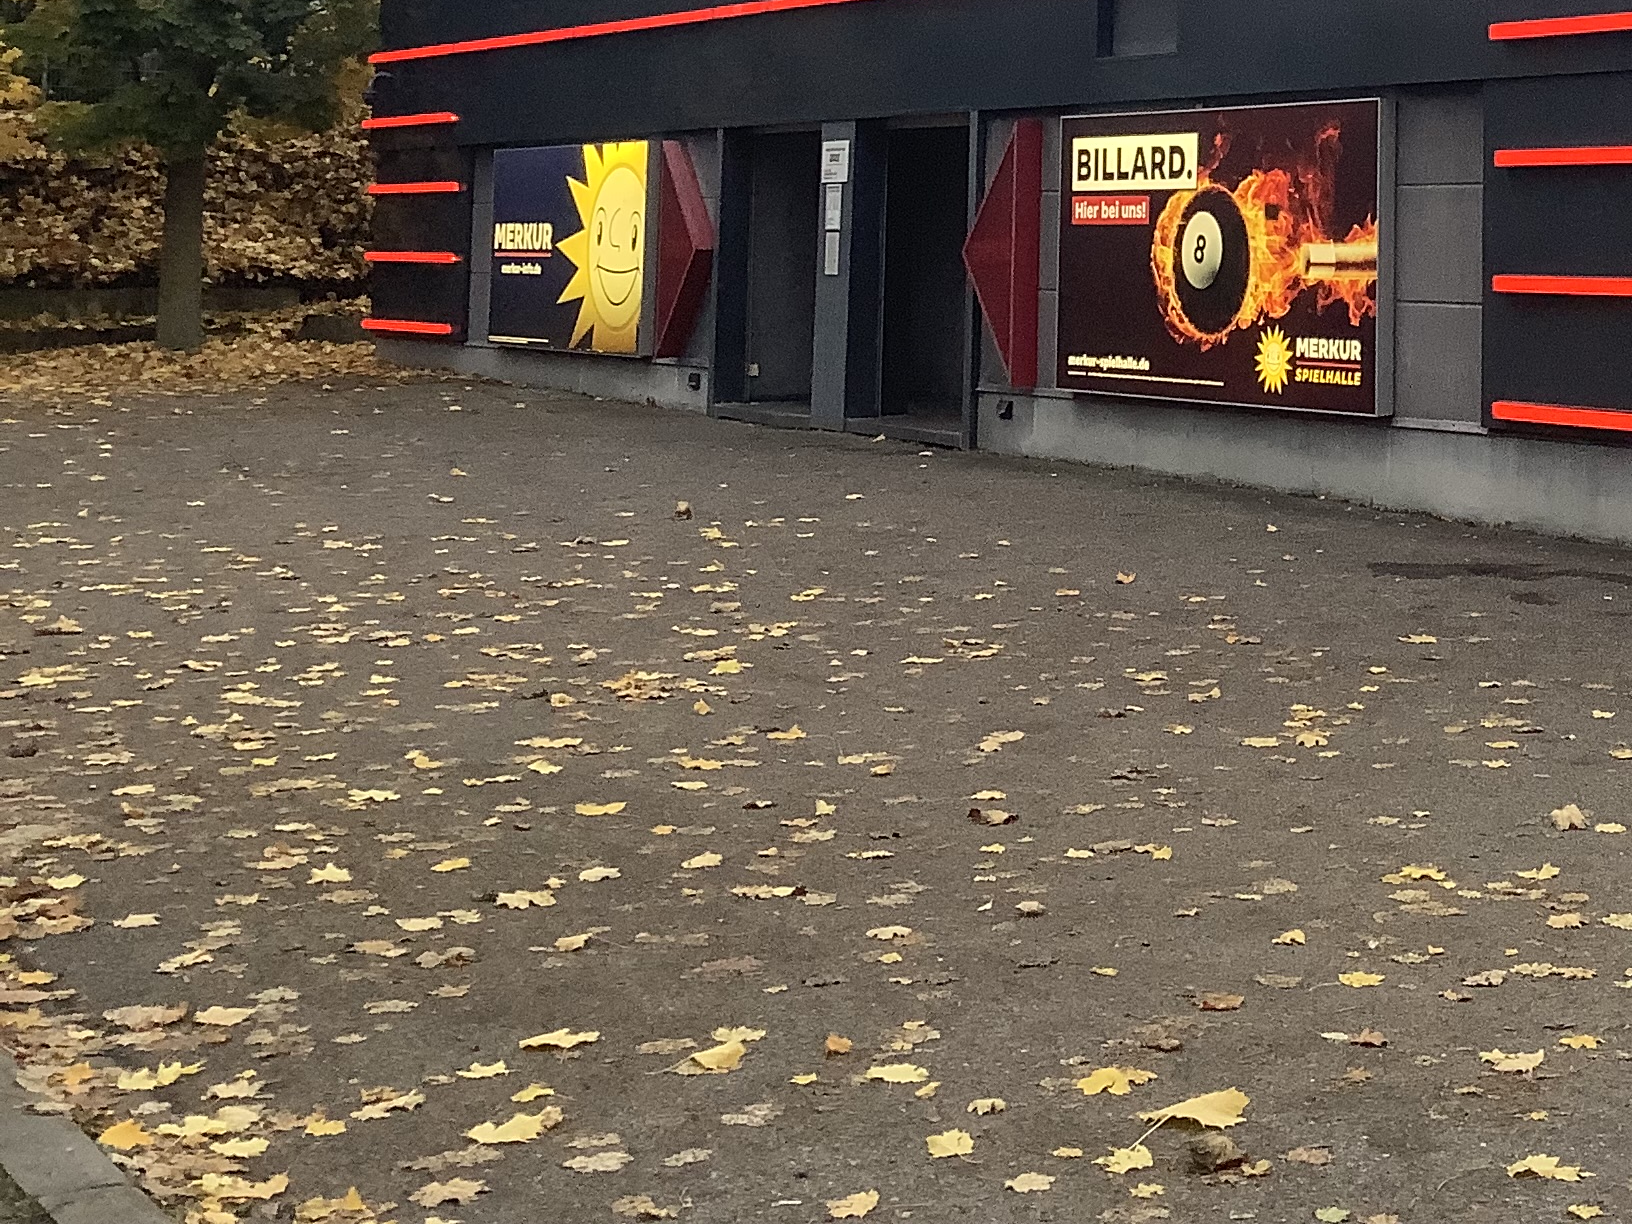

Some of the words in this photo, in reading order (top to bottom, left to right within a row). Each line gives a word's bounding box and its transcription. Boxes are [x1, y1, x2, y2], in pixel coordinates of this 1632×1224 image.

[1077, 145, 1193, 182] BILLARD.
[1075, 201, 1099, 219] Hier
[1100, 200, 1120, 219] bei
[1121, 201, 1147, 219] uns!
[493, 222, 553, 250] MERKUR
[1194, 234, 1206, 265] 8
[1295, 337, 1362, 361] MERKUR
[1294, 367, 1362, 386] SPIELHALLE
